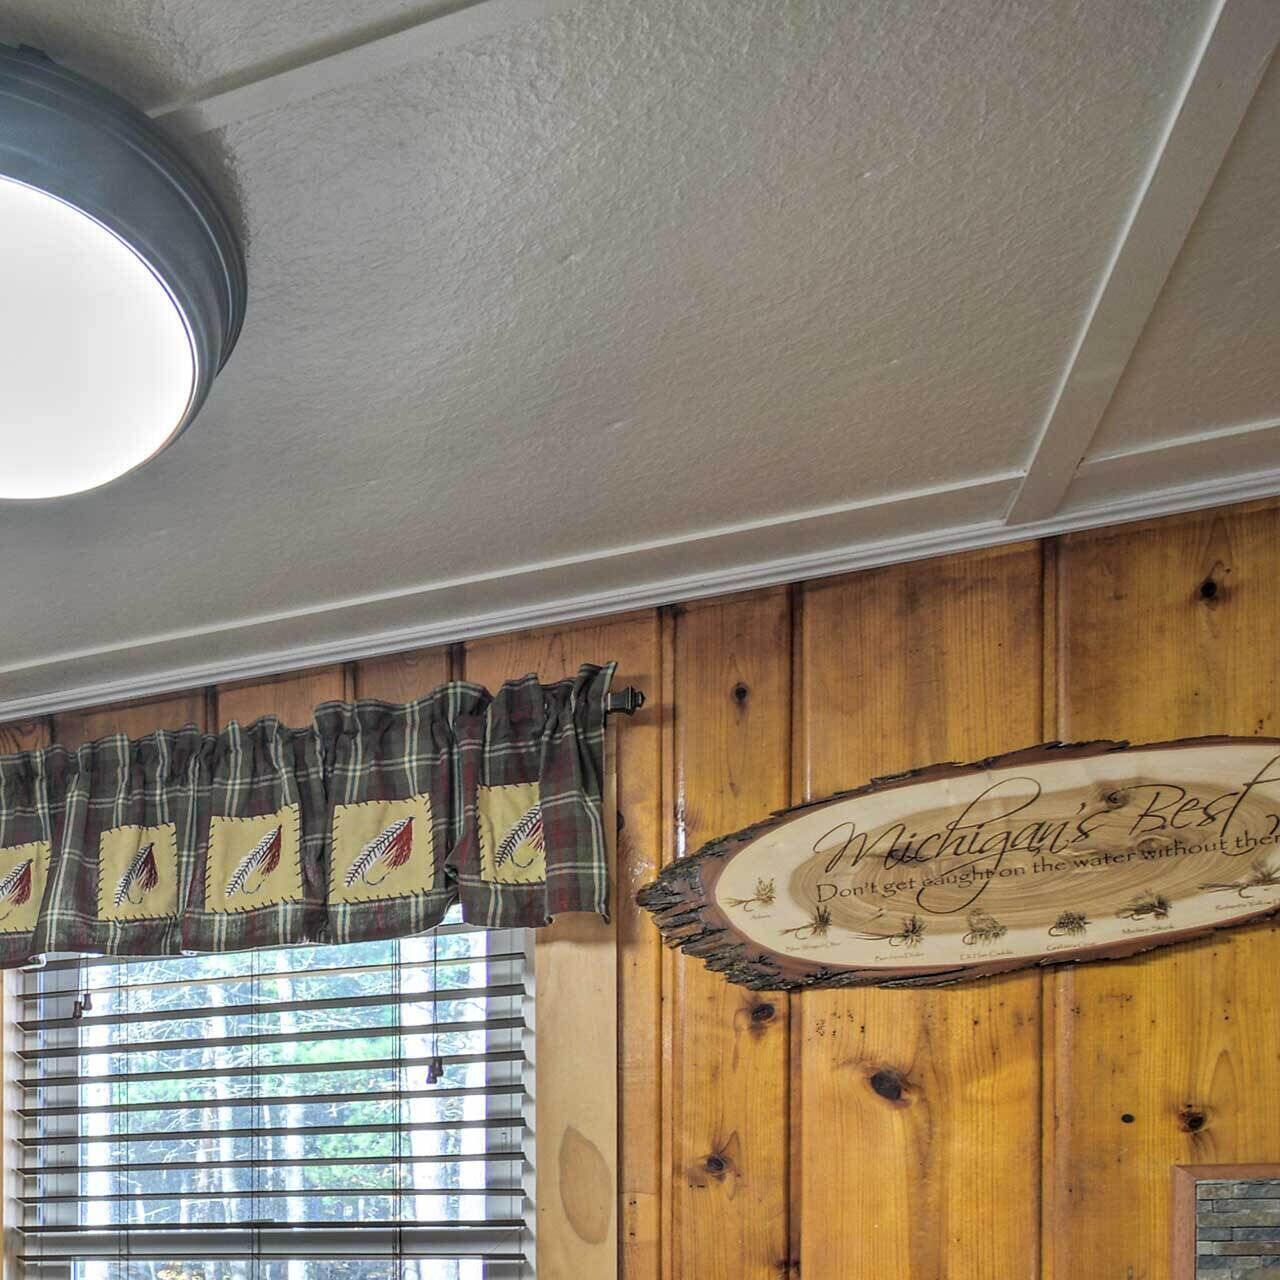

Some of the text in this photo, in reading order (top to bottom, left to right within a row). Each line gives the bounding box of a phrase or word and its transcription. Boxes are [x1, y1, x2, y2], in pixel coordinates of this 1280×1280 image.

[813, 754, 1280, 913] Michigan's Best
[816, 880, 878, 903] Don't
[883, 878, 917, 897] get
[921, 865, 993, 888] caught
[998, 865, 1025, 878] on
[1033, 855, 1067, 873] the
[1073, 851, 1137, 867] water
[1140, 838, 1228, 860] without
